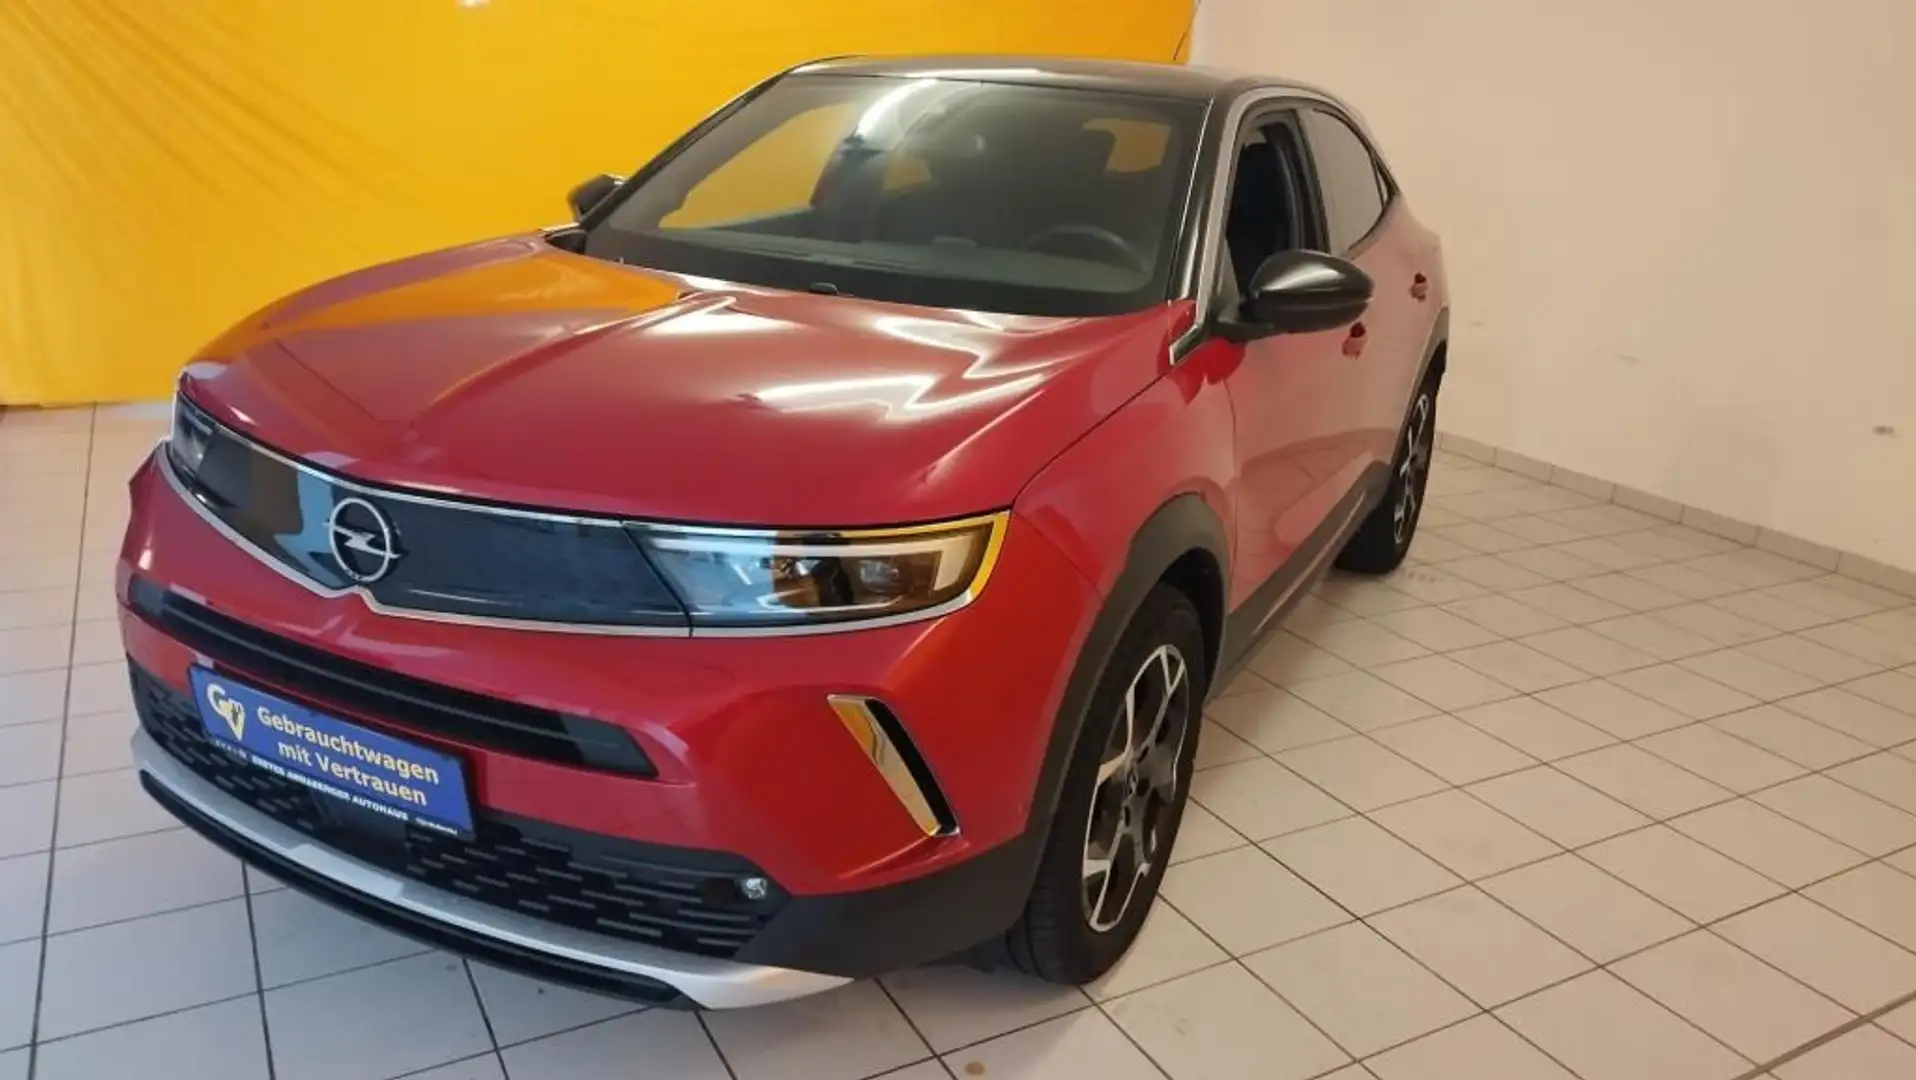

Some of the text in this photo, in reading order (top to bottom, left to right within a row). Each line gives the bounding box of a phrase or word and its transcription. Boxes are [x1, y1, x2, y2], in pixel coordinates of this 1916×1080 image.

[257, 705, 440, 785] Gebrauchtwagen
[277, 741, 312, 767] mit
[314, 751, 428, 807] Vertrauen
[352, 795, 409, 821] AUTOHAUS
